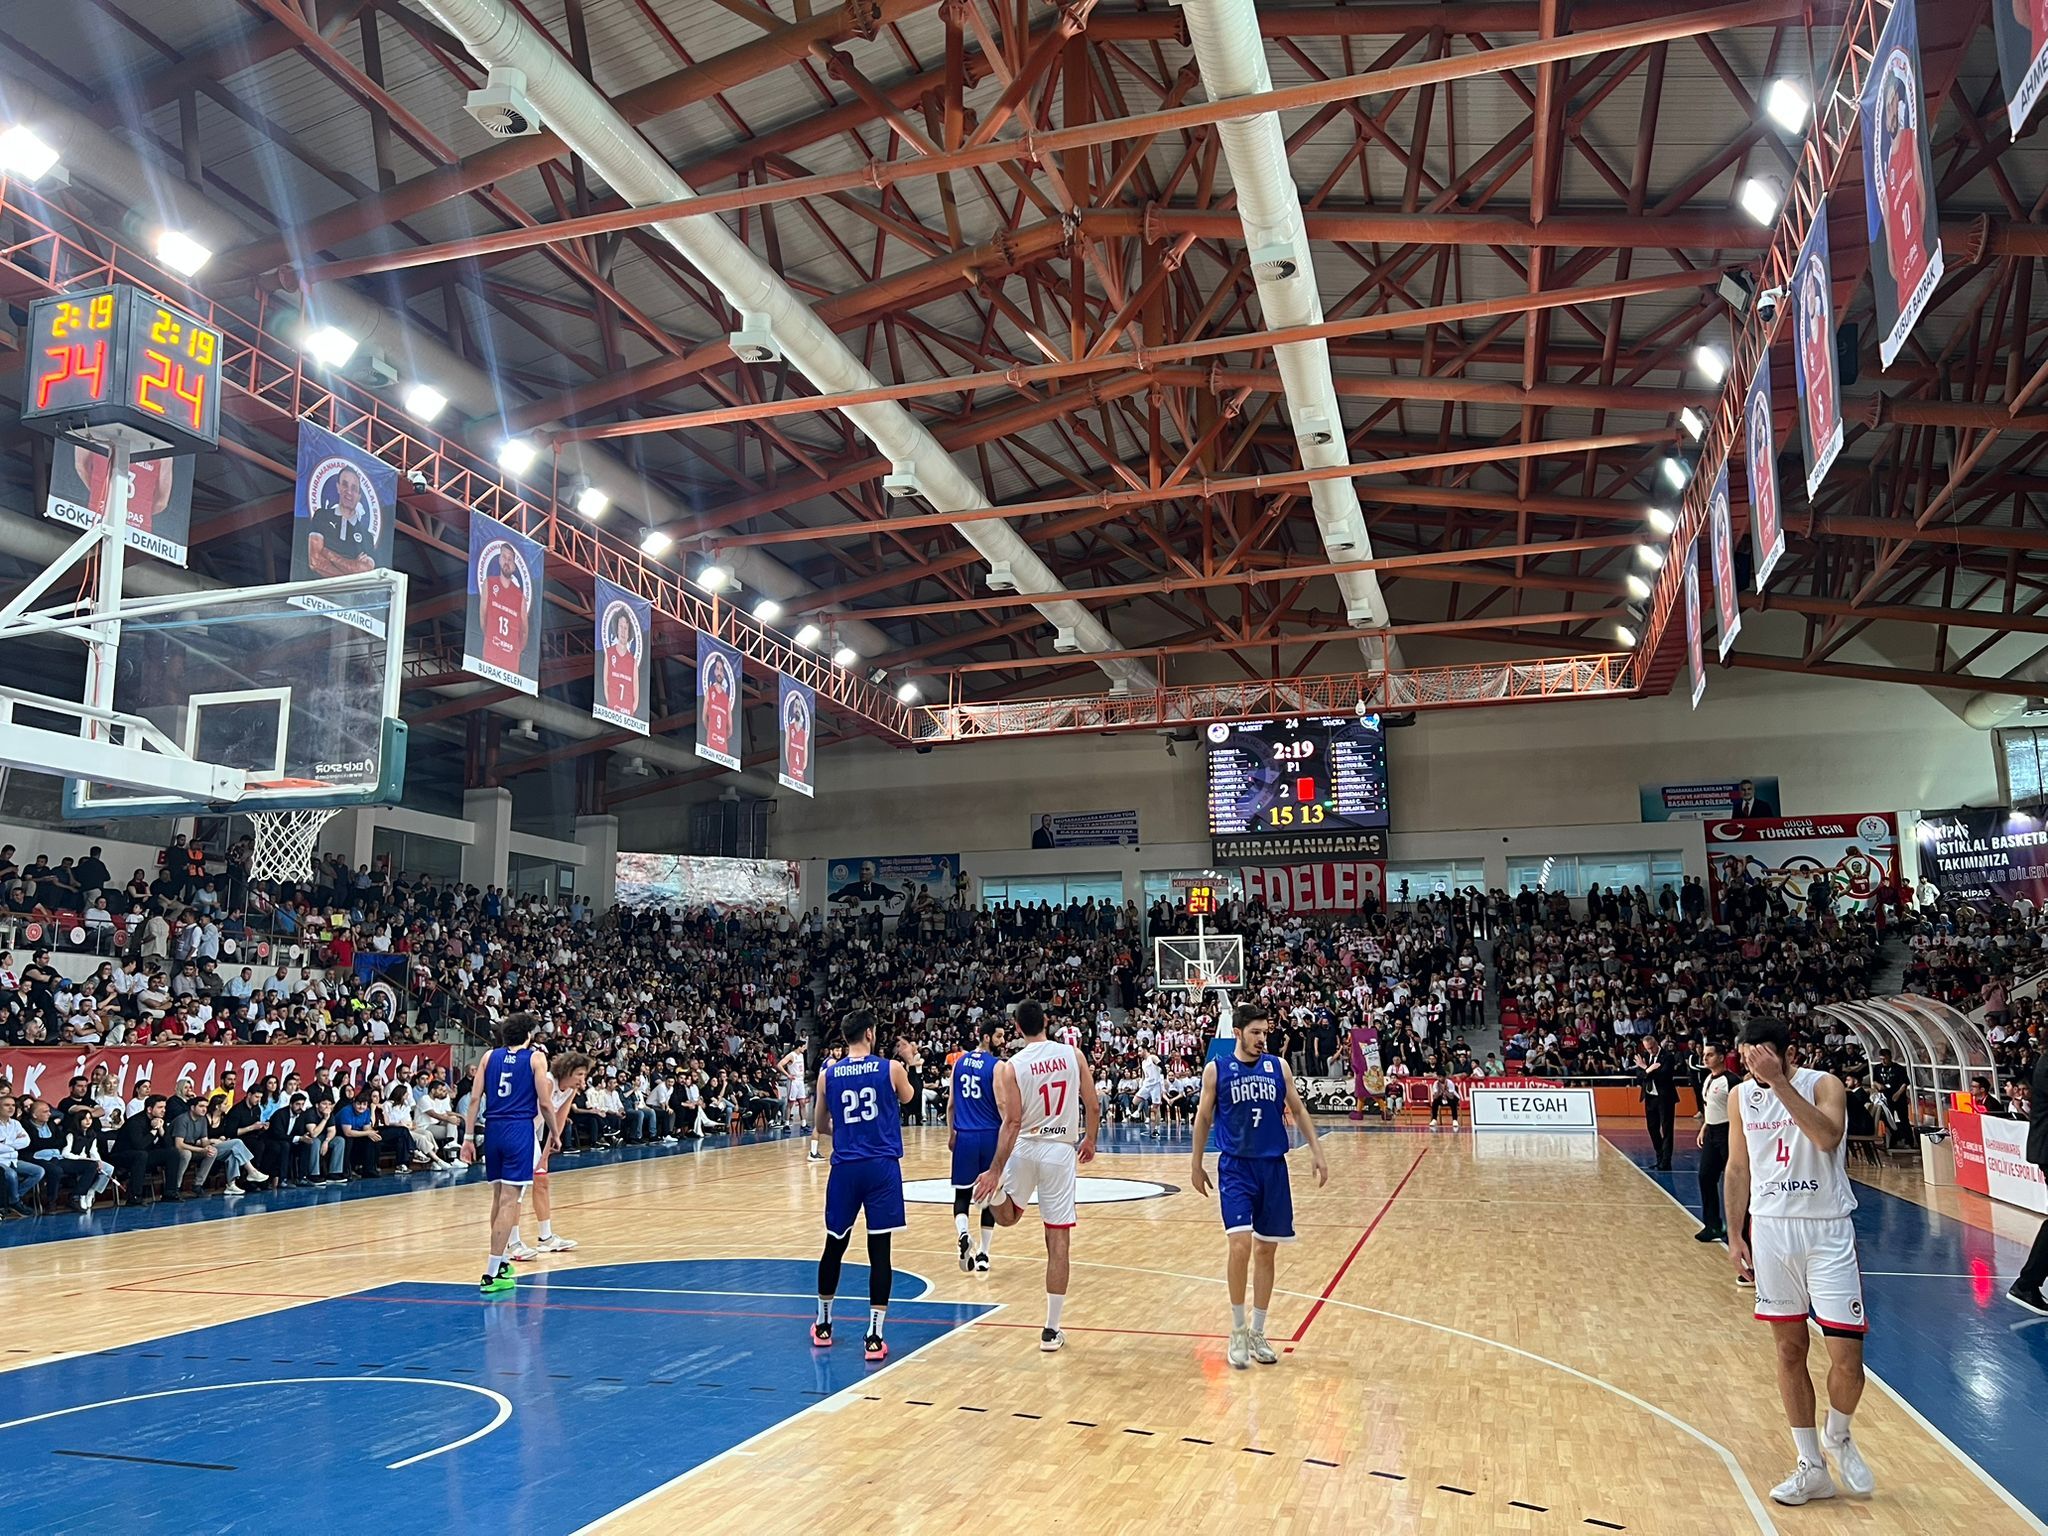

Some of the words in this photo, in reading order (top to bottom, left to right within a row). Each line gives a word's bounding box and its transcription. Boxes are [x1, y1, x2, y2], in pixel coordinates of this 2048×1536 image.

[1893, 308, 1912, 345] YUSUF
[1911, 264, 1937, 313] BAYRAK
[52, 294, 113, 337] 2:19
[151, 309, 215, 366] 2:19
[138, 348, 204, 430] 24
[131, 532, 178, 560] DEMİRLİ
[337, 608, 373, 630] DEMİRCİ
[499, 616, 509, 636] 13
[478, 662, 502, 680] BURAK
[503, 672, 523, 687] SELEN
[620, 684, 625, 701] 7
[1286, 718, 1299, 729] 24
[1273, 740, 1314, 760] 2:19
[1287, 762, 1300, 772] P1
[1280, 785, 1289, 798] 2
[1270, 806, 1294, 826] 15
[1301, 804, 1324, 824] 13
[1784, 819, 1813, 828] GÜÇLÜ
[1756, 827, 1816, 840] TÜRKİYE
[1818, 824, 1845, 835] İÇİN
[1216, 835, 1380, 857] KAHRAMANMARAŞ
[1937, 853, 2010, 872] TAKIMIMIZA
[1962, 889, 1991, 898] KİPAŞ
[1190, 897, 1208, 912] 24
[834, 1061, 880, 1078] KORKMAZ
[1030, 1058, 1068, 1076] HAKAN
[498, 1072, 512, 1098] 5
[960, 1074, 982, 1099] 35
[1230, 1082, 1276, 1104] DAÇKA
[841, 1086, 879, 1124] 23
[1039, 1080, 1067, 1116] 17
[1496, 1098, 1568, 1112] TEZGAH
[1252, 1108, 1262, 1128] 7
[1776, 1138, 1790, 1168] 4
[2015, 1163, 2030, 1180] SPOR
[1780, 1178, 1818, 1192] KİPAŞ
